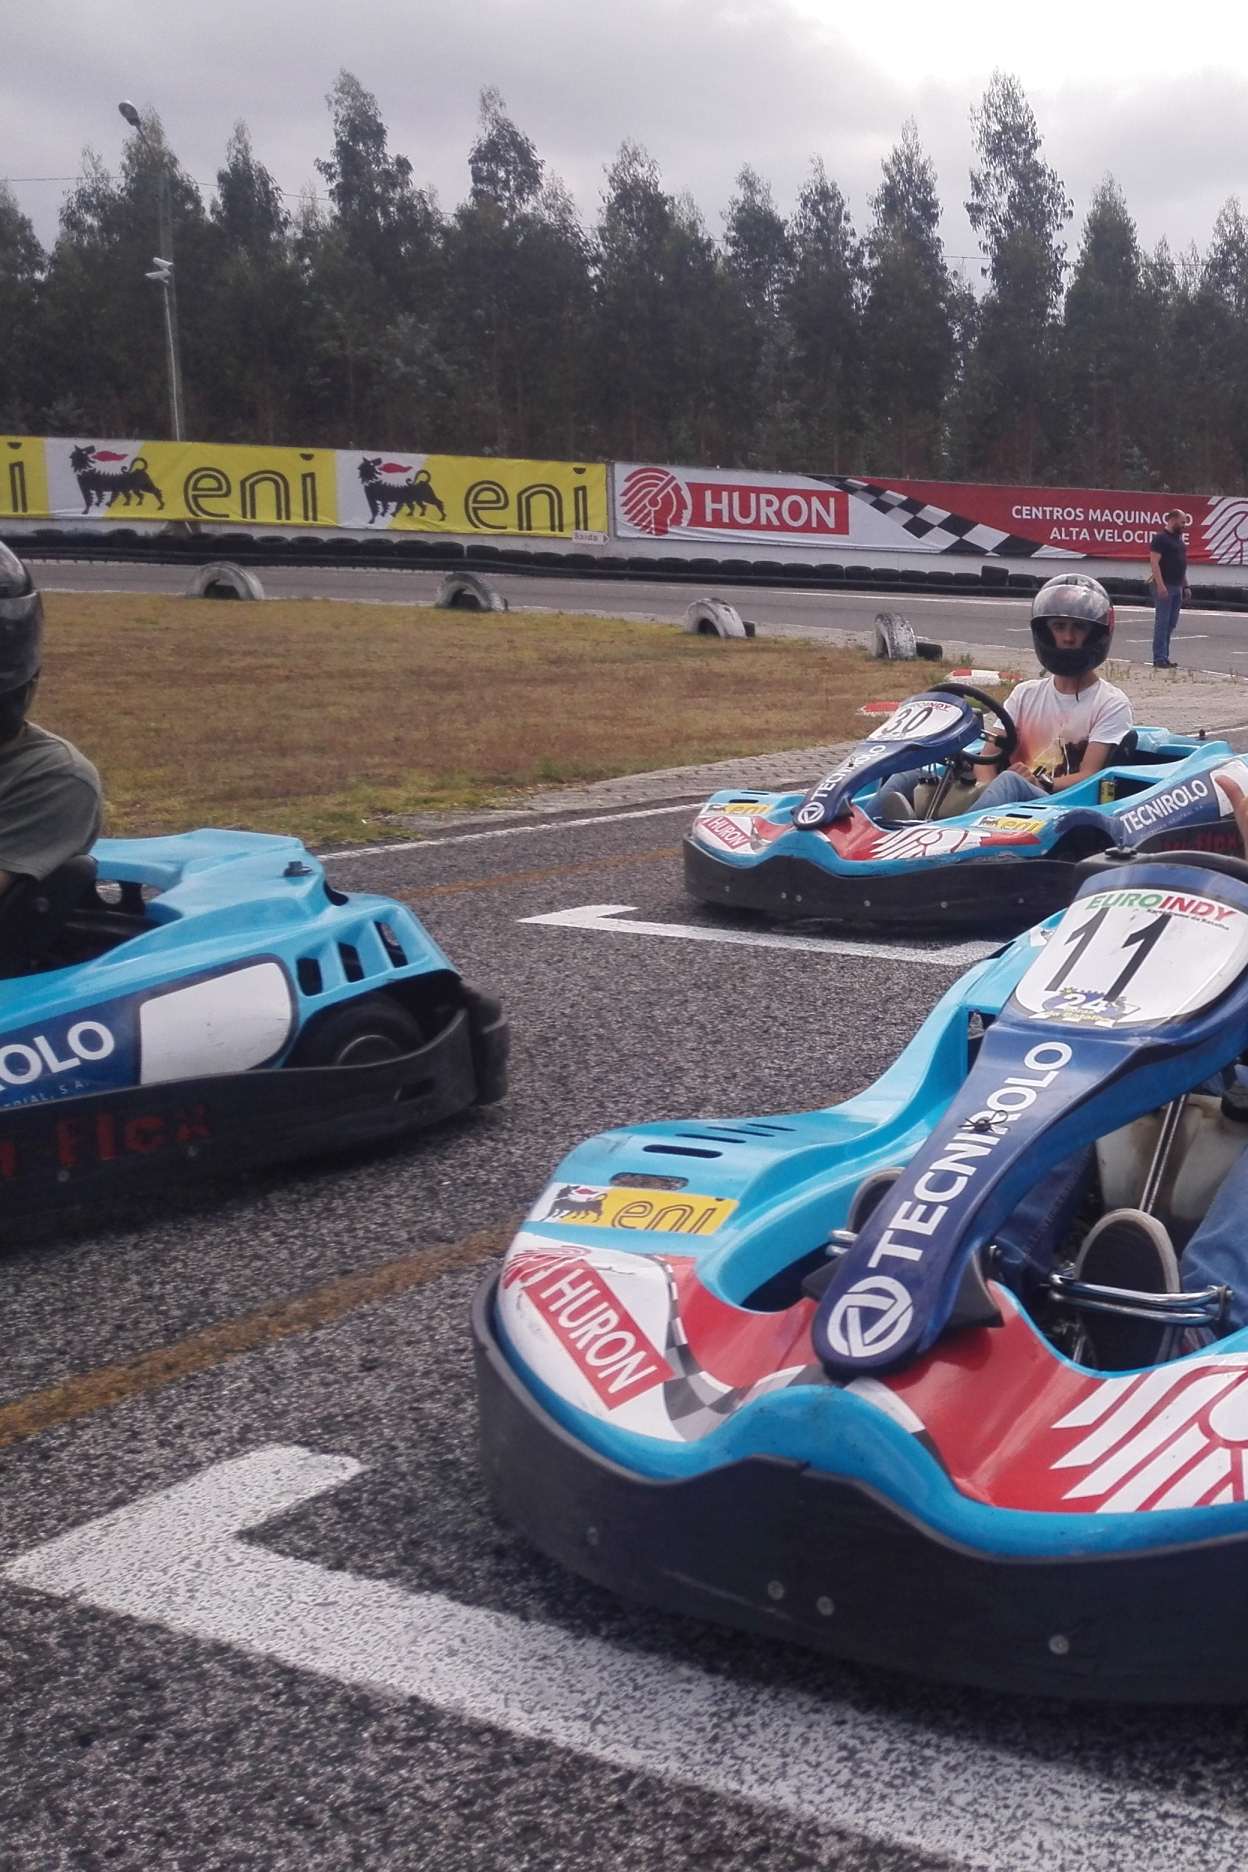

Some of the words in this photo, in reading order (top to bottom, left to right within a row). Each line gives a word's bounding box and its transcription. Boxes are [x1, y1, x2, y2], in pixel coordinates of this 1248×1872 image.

[184, 453, 318, 521] eni
[464, 467, 588, 532] eni
[704, 491, 836, 527] HURON
[1012, 505, 1084, 521] CENTROS
[1050, 528, 1090, 541] ALTA
[882, 706, 933, 734] 30
[1119, 780, 1208, 834] TECNIROLO
[709, 819, 749, 847] HURON
[1086, 893, 1237, 921] EUROINDY
[1046, 907, 1171, 1002] 11
[867, 1041, 1072, 1268] TECNIROLO
[611, 1197, 725, 1234] eni
[540, 1269, 658, 1396] HURON
